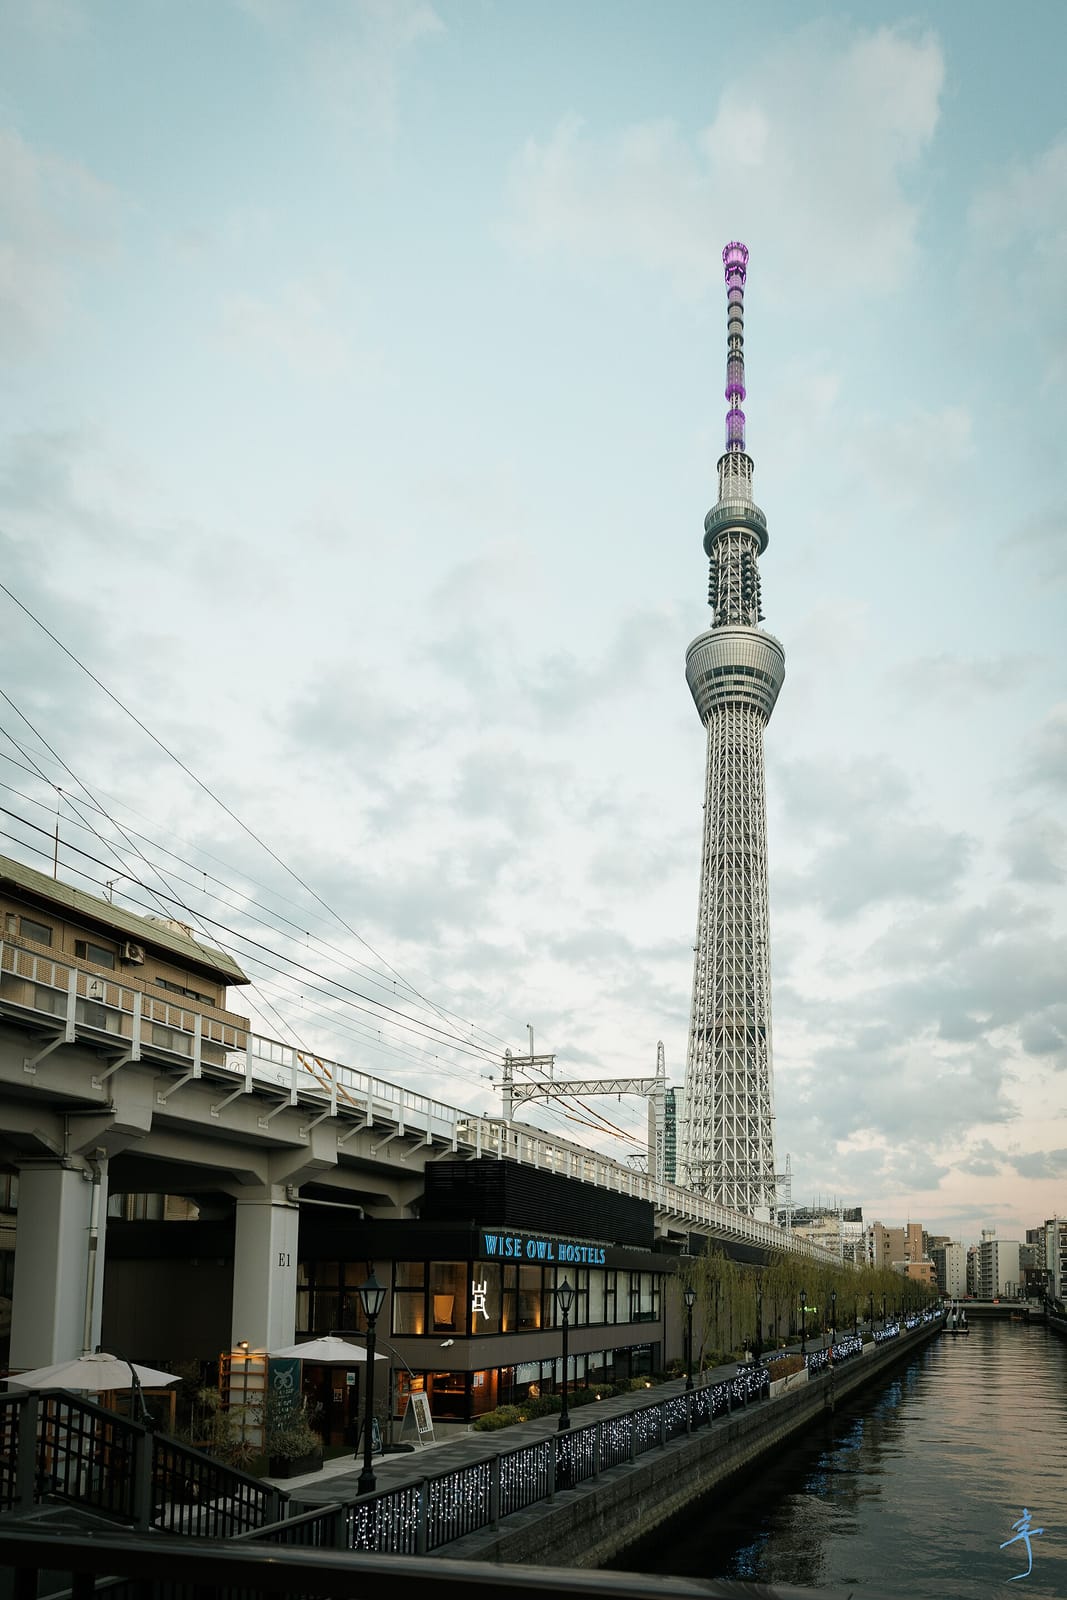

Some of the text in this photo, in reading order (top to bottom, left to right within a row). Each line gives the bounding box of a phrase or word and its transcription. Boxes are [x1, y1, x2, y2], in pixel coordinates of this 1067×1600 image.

[90, 980, 98, 990] 4
[485, 1235, 606, 1264] WISE OWL HOSTELS
[279, 1252, 290, 1267] E1
